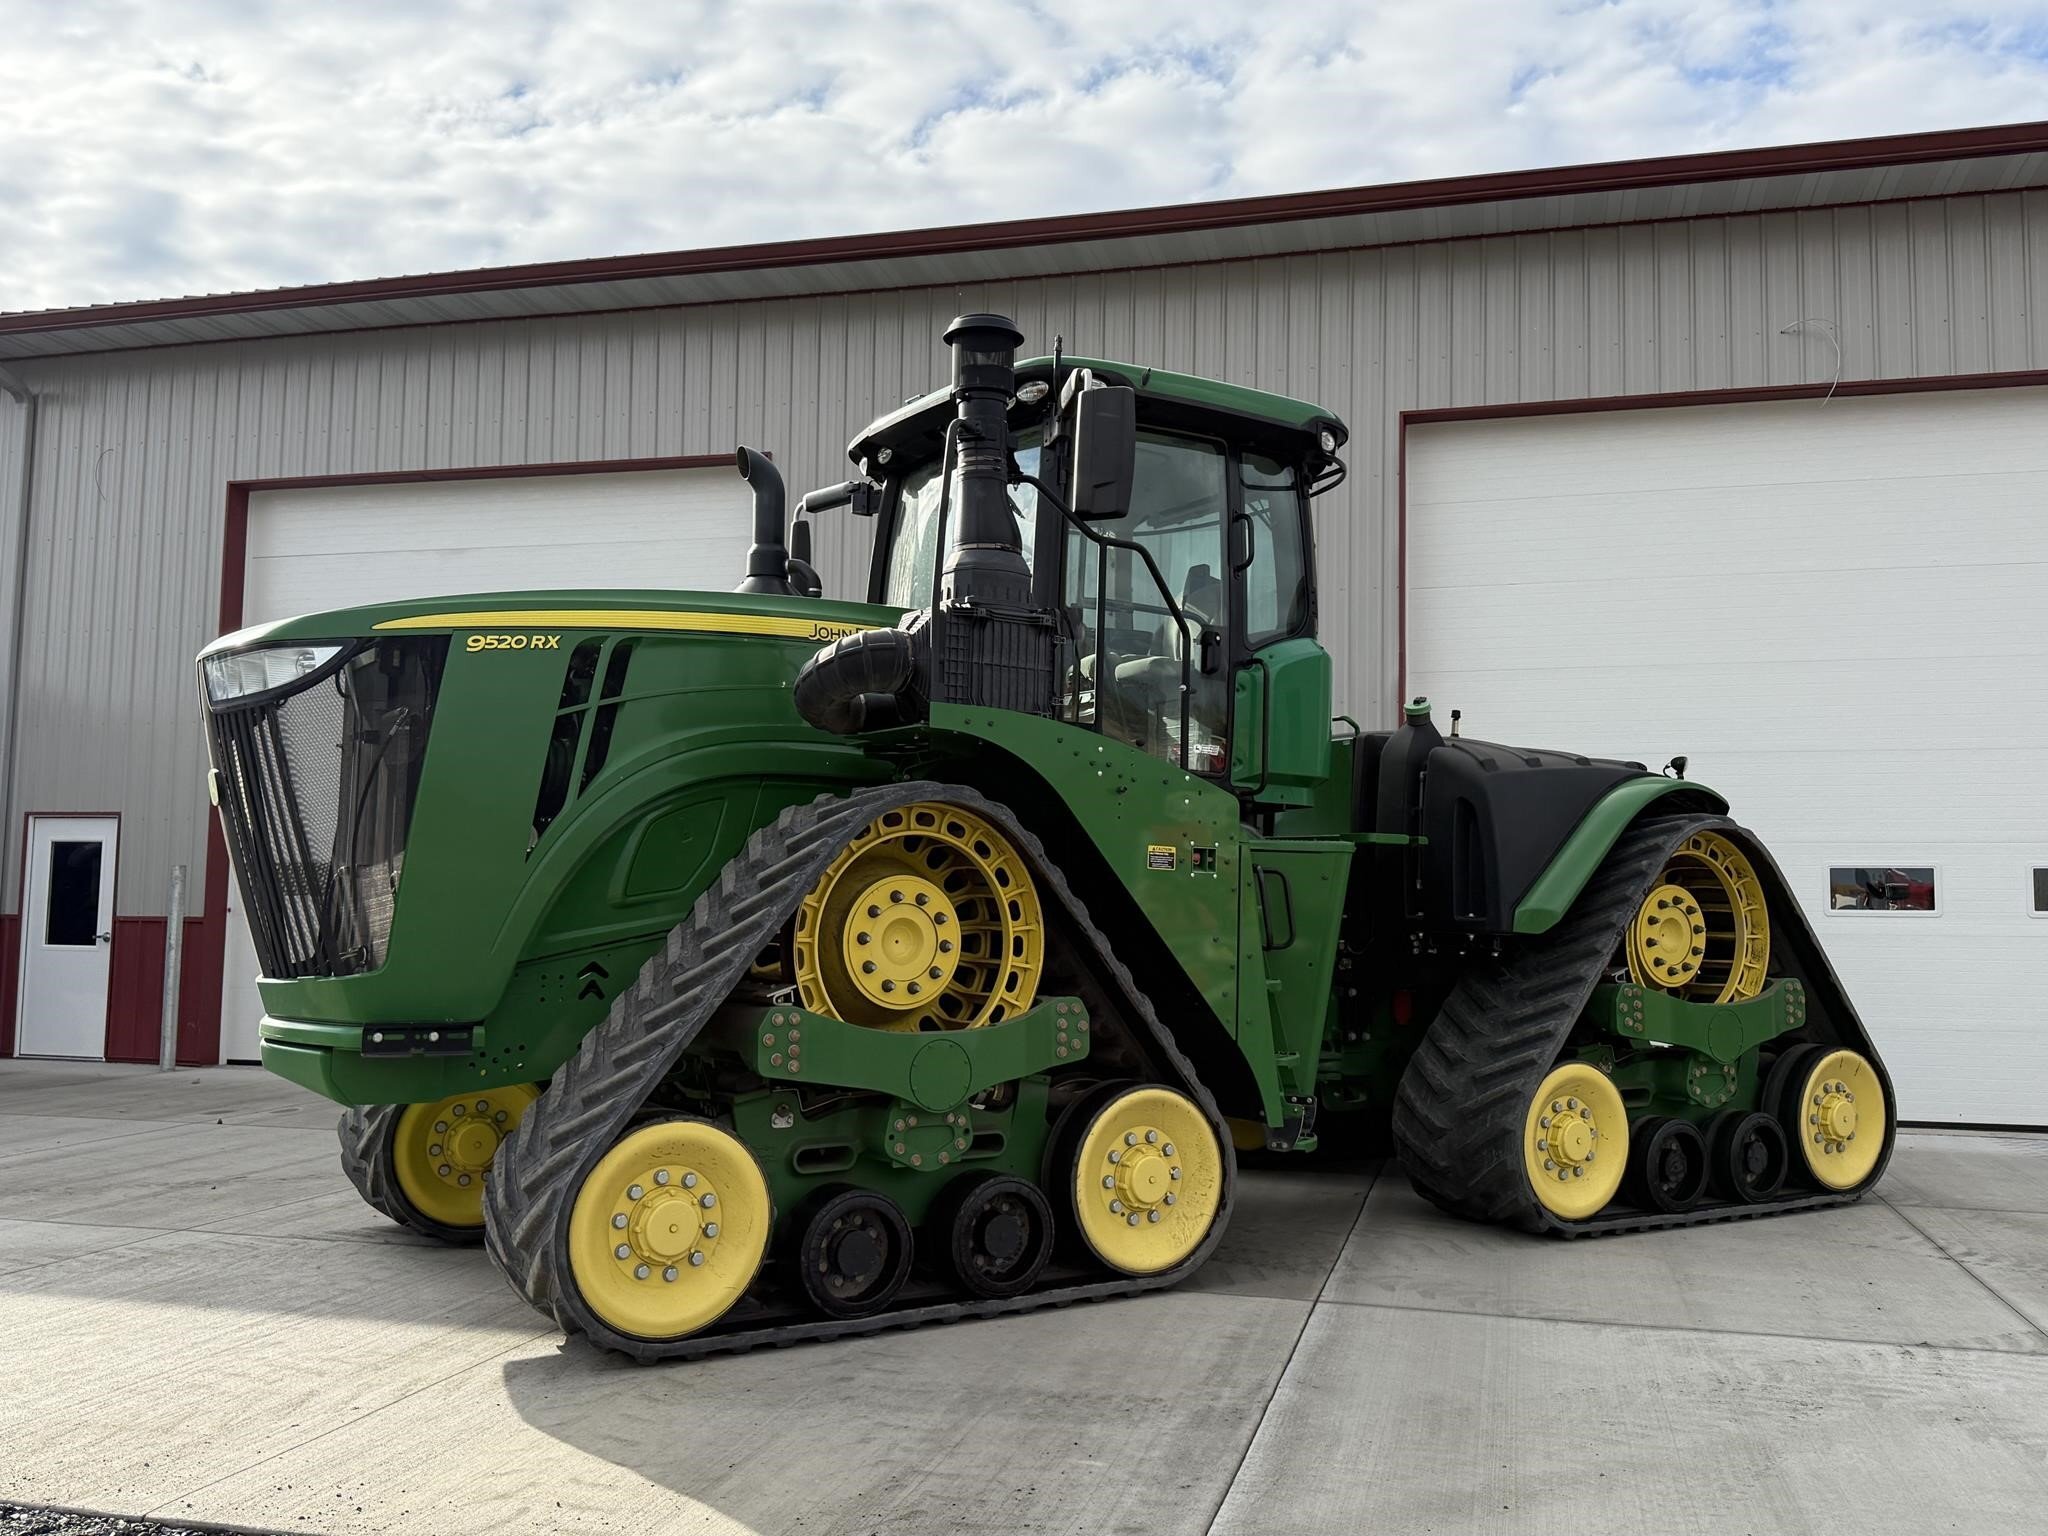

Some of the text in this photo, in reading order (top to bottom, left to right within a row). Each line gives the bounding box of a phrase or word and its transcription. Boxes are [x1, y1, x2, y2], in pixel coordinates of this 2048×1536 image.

[808, 623, 852, 639] JOHN
[466, 634, 561, 652] 9520 RX
